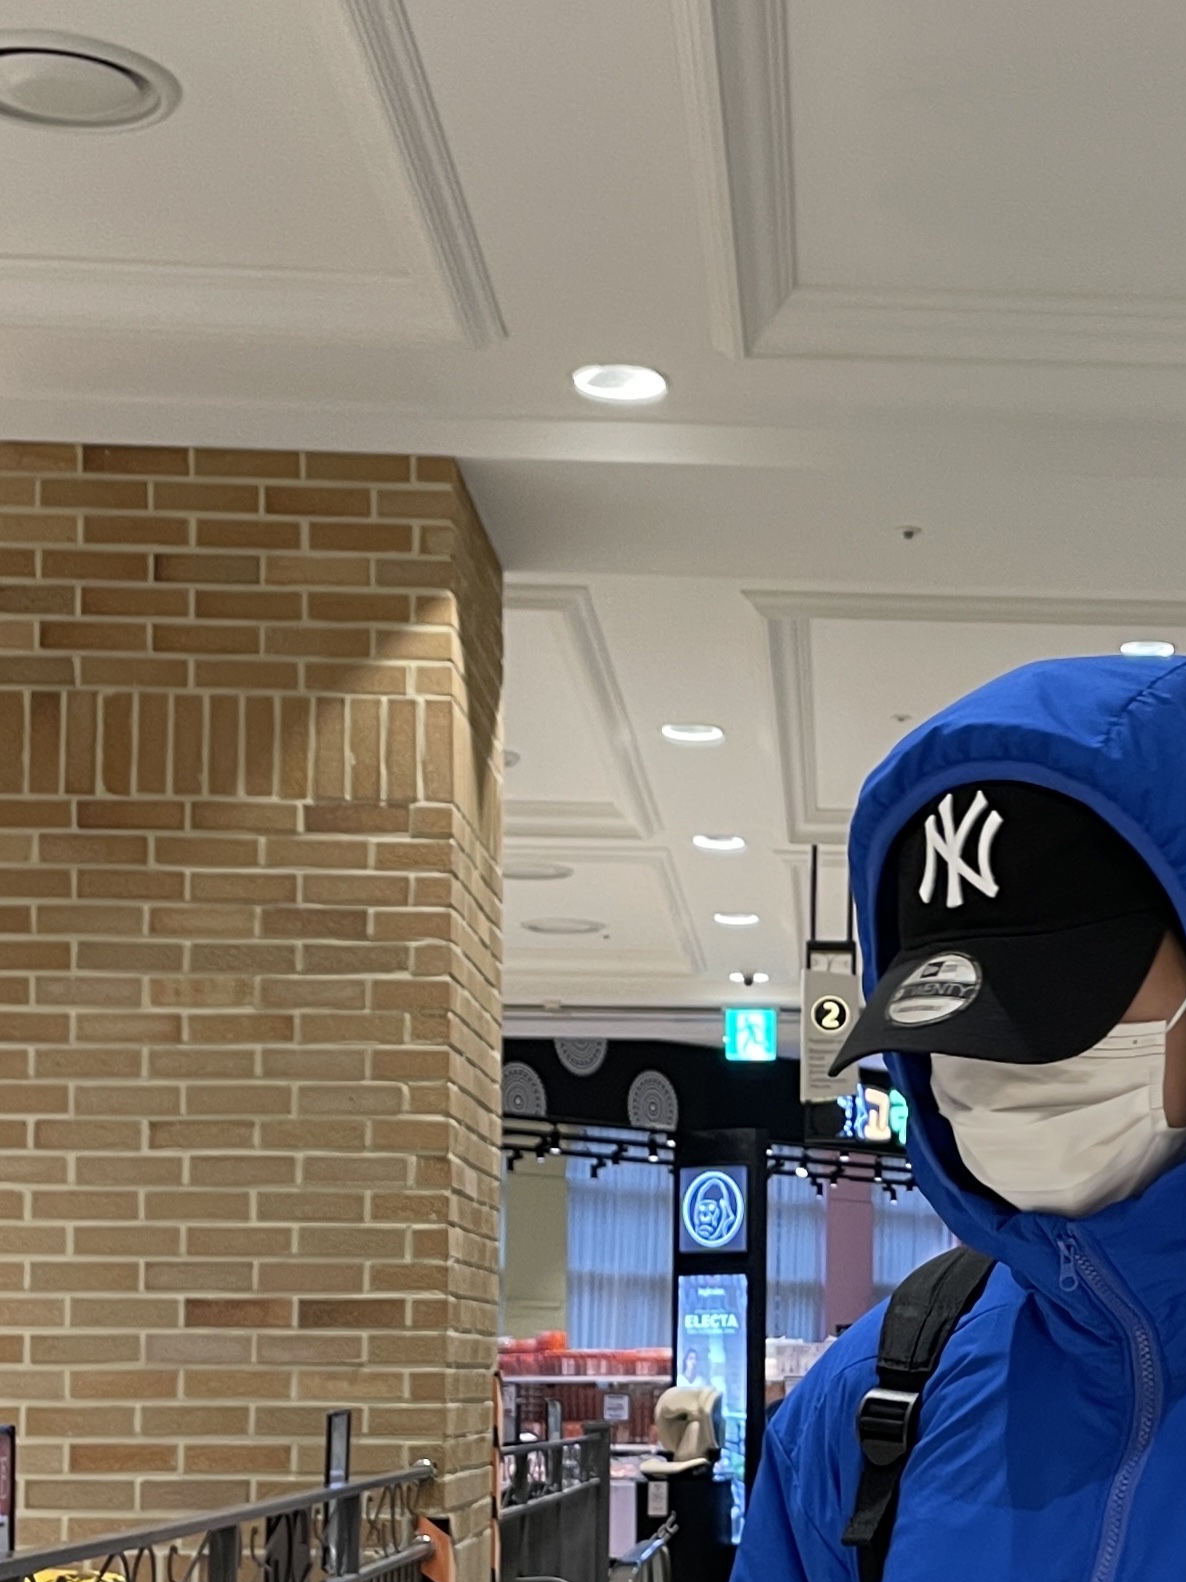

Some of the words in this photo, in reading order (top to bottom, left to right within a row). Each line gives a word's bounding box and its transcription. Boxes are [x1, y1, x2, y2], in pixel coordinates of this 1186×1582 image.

[918, 790, 1004, 909] NY
[821, 1001, 840, 1028] 2
[684, 1313, 739, 1329] ELECTA
